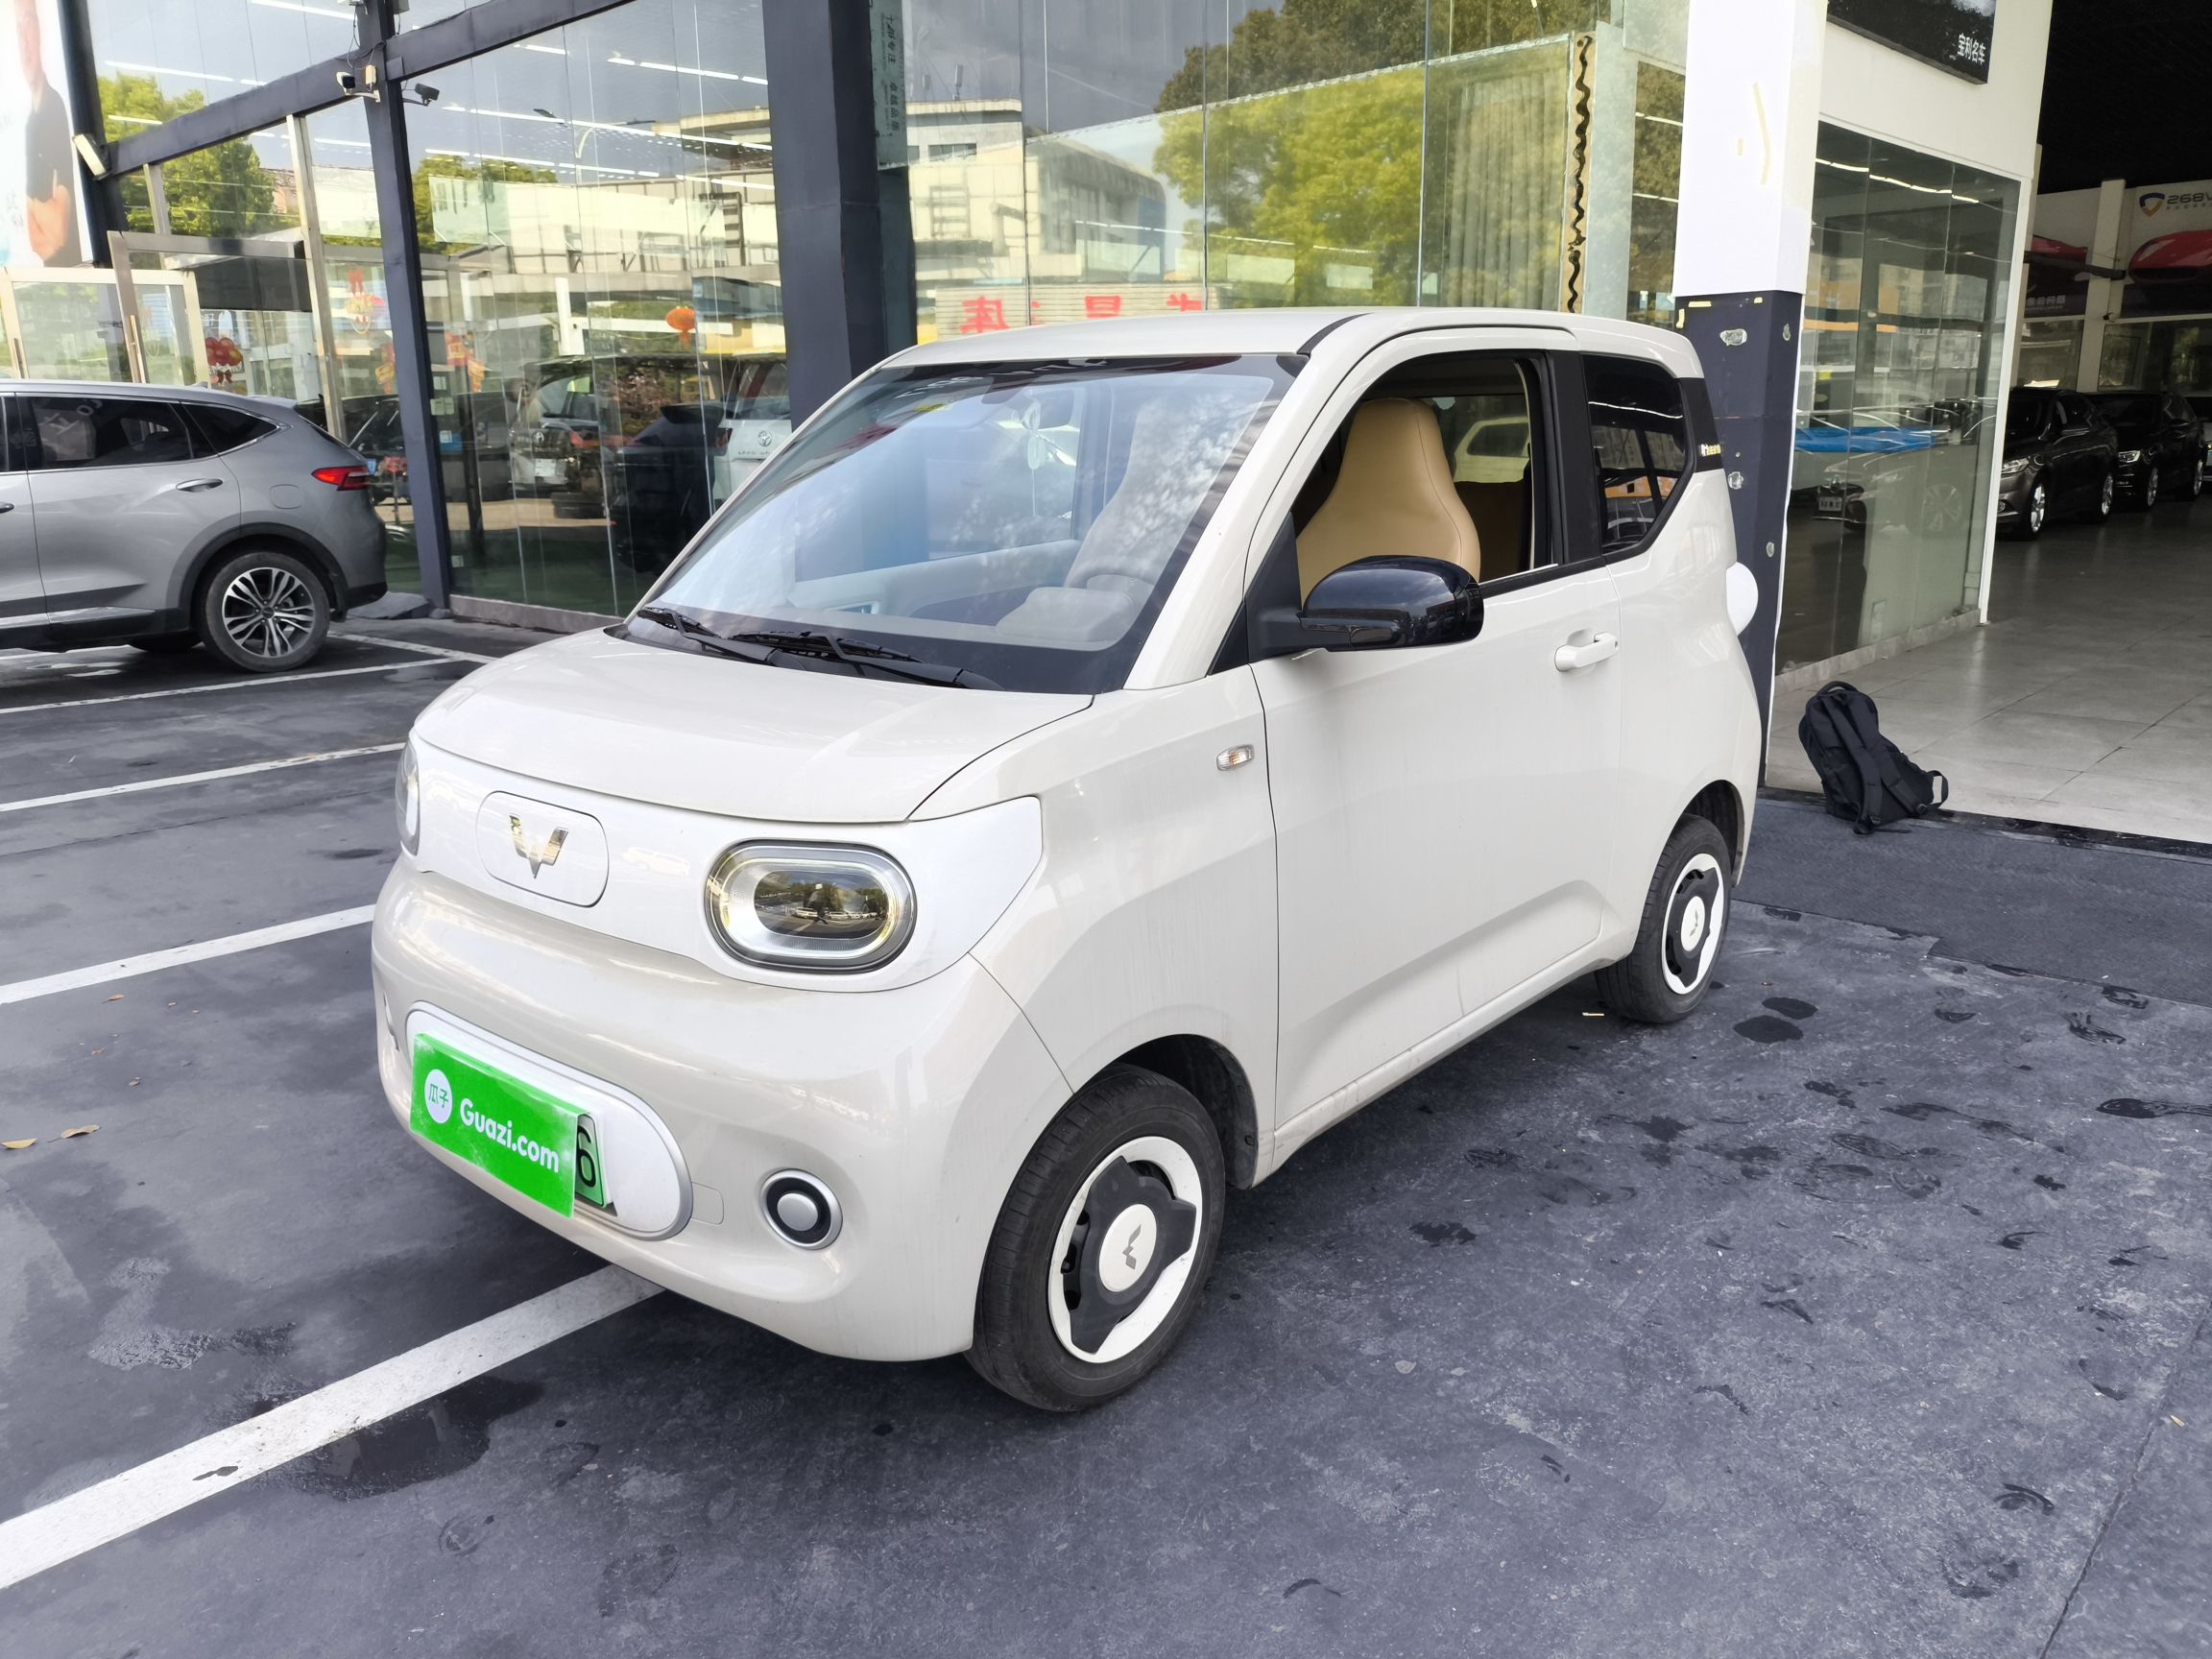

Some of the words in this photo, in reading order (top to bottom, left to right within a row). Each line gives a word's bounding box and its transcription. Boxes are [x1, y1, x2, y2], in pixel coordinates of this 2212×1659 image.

[1957, 32, 1986, 65] 宝利名车
[428, 1083, 449, 1108] 瓜子
[460, 1097, 560, 1173] Guazi.com
